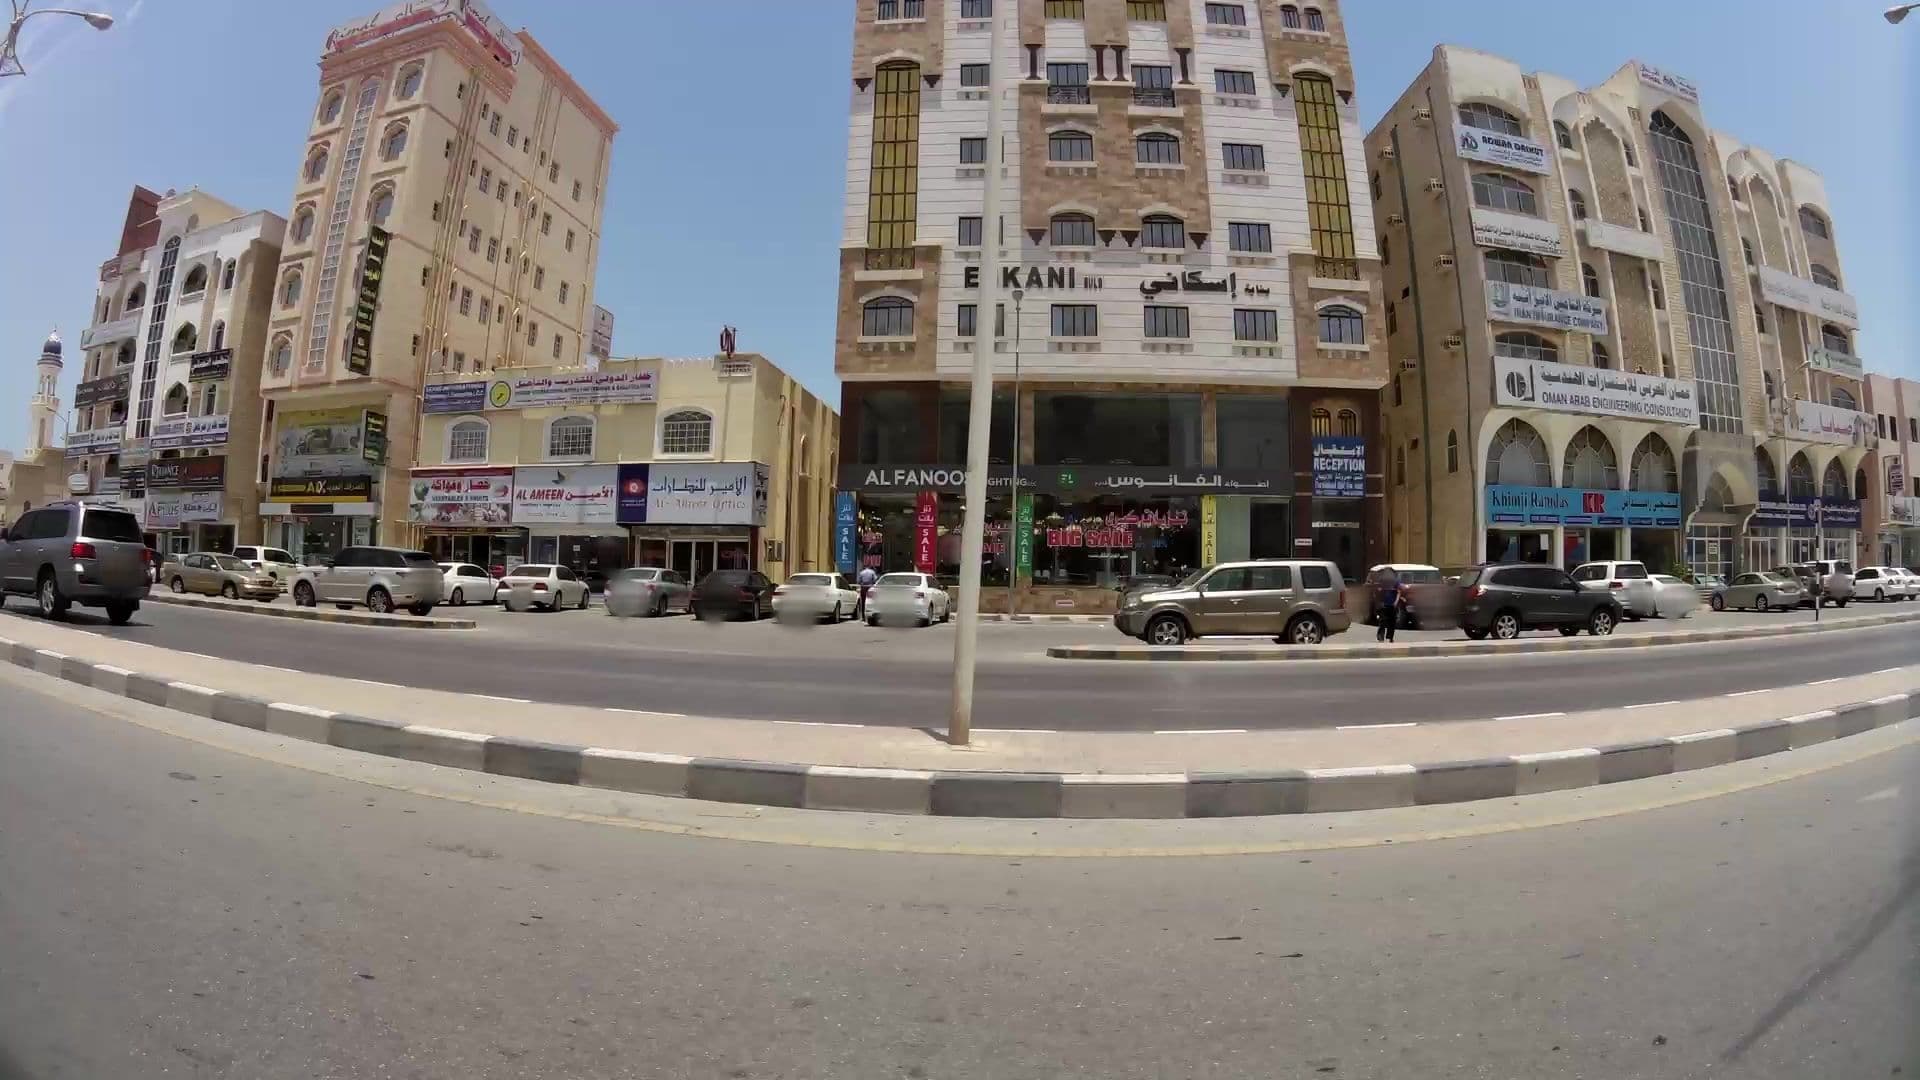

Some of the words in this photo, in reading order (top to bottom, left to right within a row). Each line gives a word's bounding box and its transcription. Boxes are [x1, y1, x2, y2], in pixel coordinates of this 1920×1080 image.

[964, 266, 1075, 289] EKANI
[1542, 391, 1568, 405] OMAN
[1569, 394, 1591, 407] ARAB
[1592, 396, 1643, 413] ENGINEERING
[1643, 403, 1692, 420] CONSULTANCY
[1313, 457, 1366, 473] RECEPTION
[864, 469, 891, 486] AL
[894, 469, 968, 486] FANOO
[1107, 473, 1222, 489] الفانوس
[516, 488, 528, 501] AL
[529, 488, 565, 501] AMEEN
[1491, 490, 1528, 512] Khimji
[1531, 492, 1569, 509] Ramdas
[841, 527, 850, 561] SALE
[921, 528, 930, 562] SALE
[1020, 530, 1029, 563] SALE
[1046, 528, 1083, 548] BIG
[1086, 528, 1134, 548] SALE
